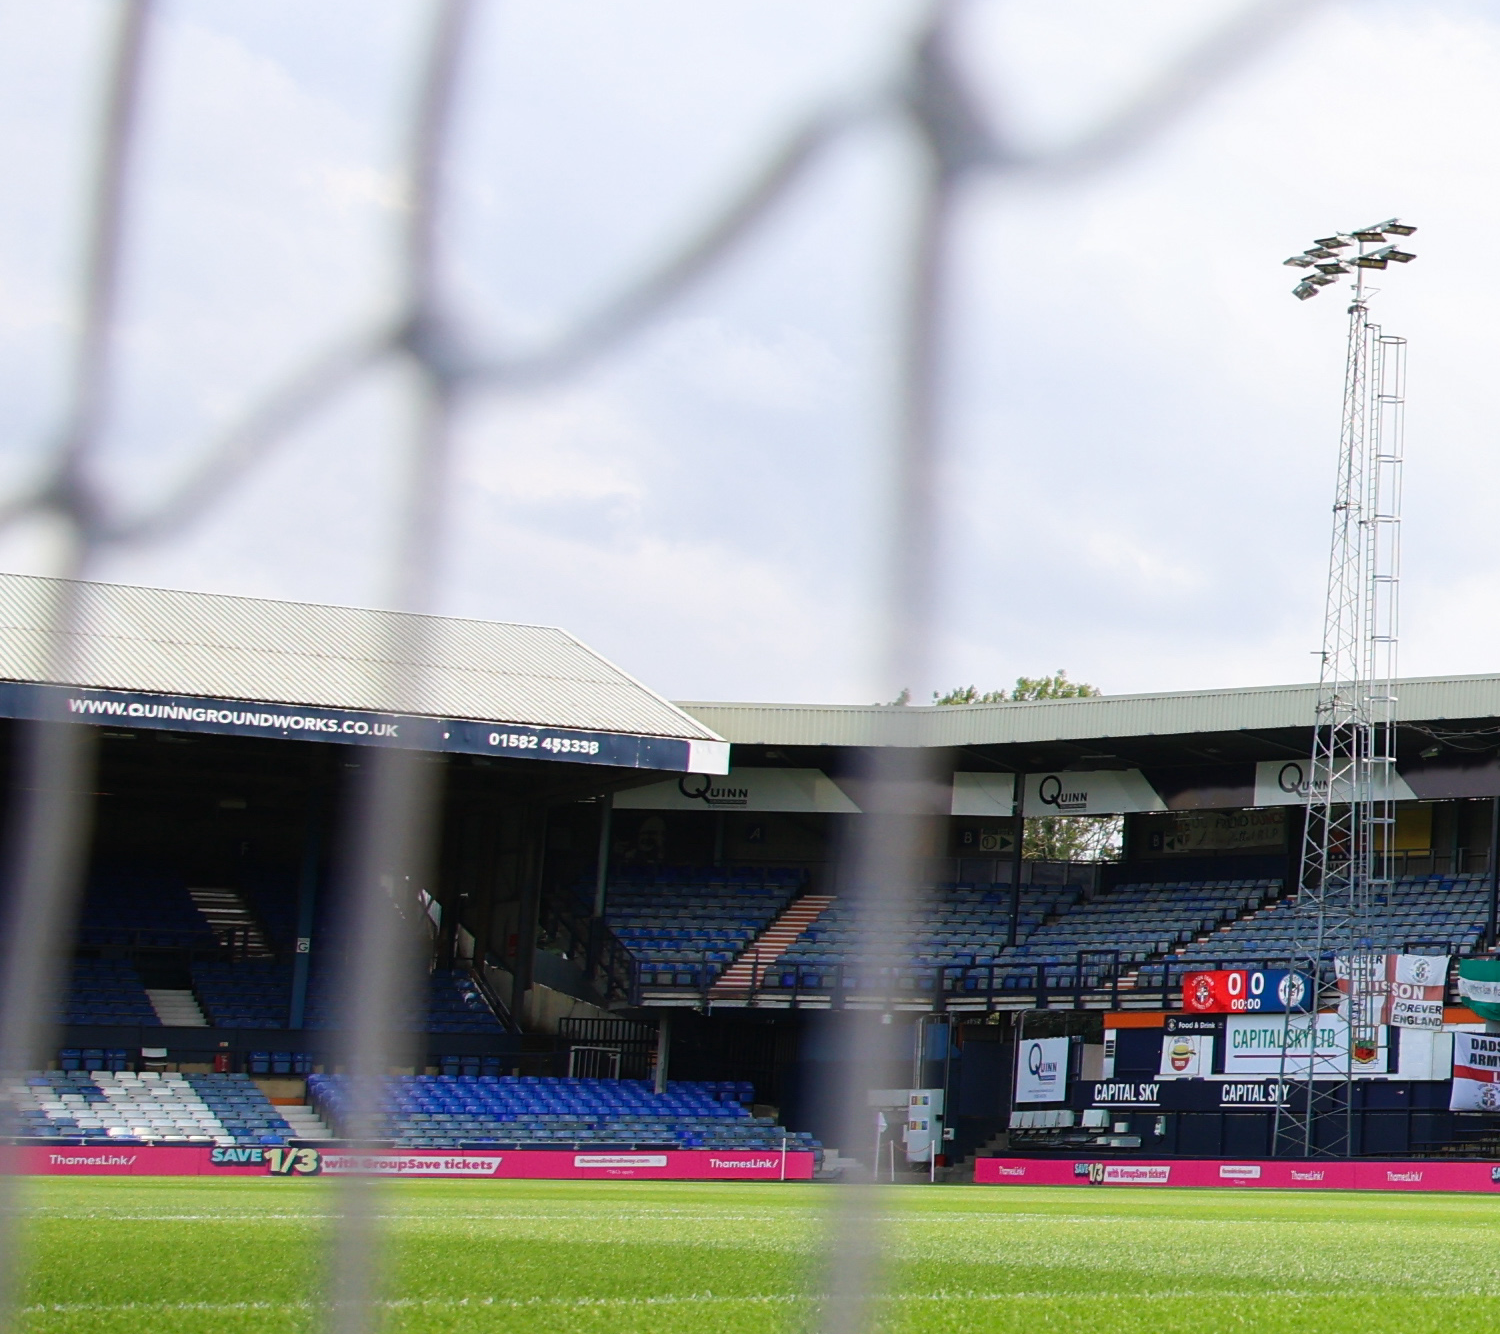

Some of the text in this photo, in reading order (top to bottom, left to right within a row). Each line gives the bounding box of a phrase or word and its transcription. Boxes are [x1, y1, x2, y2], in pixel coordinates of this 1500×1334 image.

[68, 698, 399, 738] WWW.QUINNGROUNDWORKS.CO.UK
[489, 733, 599, 755] 01582 453338
[679, 774, 748, 804] QUINN
[1039, 775, 1088, 809] QUINN
[1227, 972, 1264, 996] 0 0
[1231, 998, 1261, 1010] 00:00
[1394, 1002, 1442, 1015] FOREVER
[1178, 1021, 1192, 1029] Food
[1199, 1021, 1216, 1029] Drink
[1392, 1015, 1442, 1027] ENGLAND
[1233, 1028, 1283, 1049] CAPITAL
[1094, 1084, 1160, 1101] CAPITAL SKY
[1222, 1084, 1266, 1101] CAPITAL
[211, 1148, 319, 1173] SAVE 1/3
[444, 1158, 493, 1170] tickets
